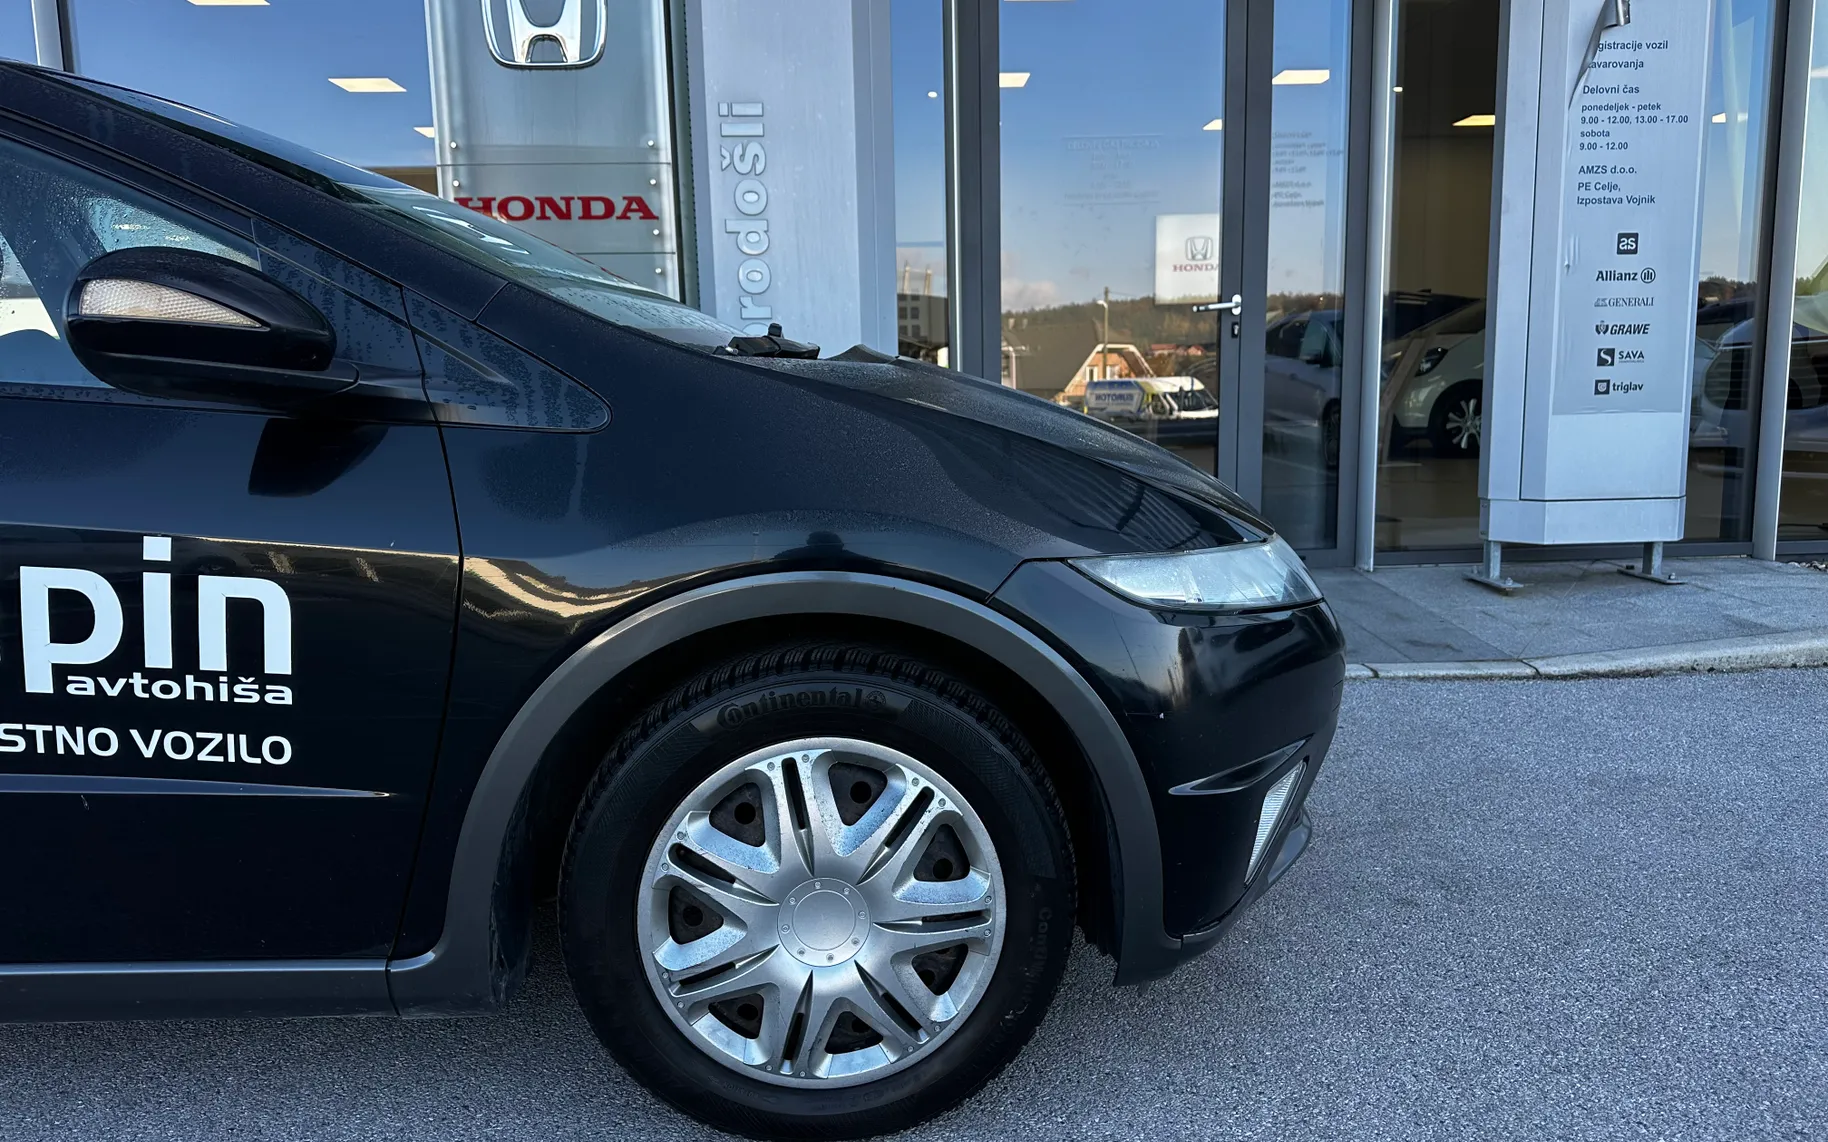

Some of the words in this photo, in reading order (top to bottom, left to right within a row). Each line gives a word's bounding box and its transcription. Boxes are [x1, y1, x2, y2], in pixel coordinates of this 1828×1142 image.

[1598, 41, 1643, 52] gistracije
[1645, 40, 1669, 50] vozil
[1582, 84, 1620, 95] Delovni
[1622, 84, 1640, 94] čas
[1581, 102, 1630, 113] ponedeljek
[1637, 102, 1662, 112] petek
[1580, 116, 1599, 125] 9.00
[1607, 115, 1632, 125] 12.00,
[1634, 115, 1658, 124] 13.00
[1666, 115, 1689, 124] 17.00
[1580, 129, 1610, 138] sobota
[1579, 142, 1598, 151] 9.00
[1605, 142, 1629, 150] 12.00
[1578, 165, 1608, 175] AMZS
[1610, 164, 1637, 174] d.o.o.
[1577, 182, 1591, 191] PE
[1594, 181, 1621, 192] Celje,
[1576, 196, 1623, 207] Izpostava
[1626, 195, 1656, 205] Vojnik
[454, 195, 659, 221] HONDA
[1618, 237, 1636, 251] as
[1595, 270, 1638, 282] Allianz
[1608, 297, 1654, 307] GENERALI
[1609, 323, 1650, 335] GRAWE
[1618, 350, 1645, 360] SAVA
[1612, 381, 1644, 394] triglav
[20, 535, 292, 694] pin
[65, 672, 293, 705] avtohiša
[716, 686, 863, 731] Continental
[0, 723, 119, 757] STNO
[129, 728, 292, 766] VOZILO
